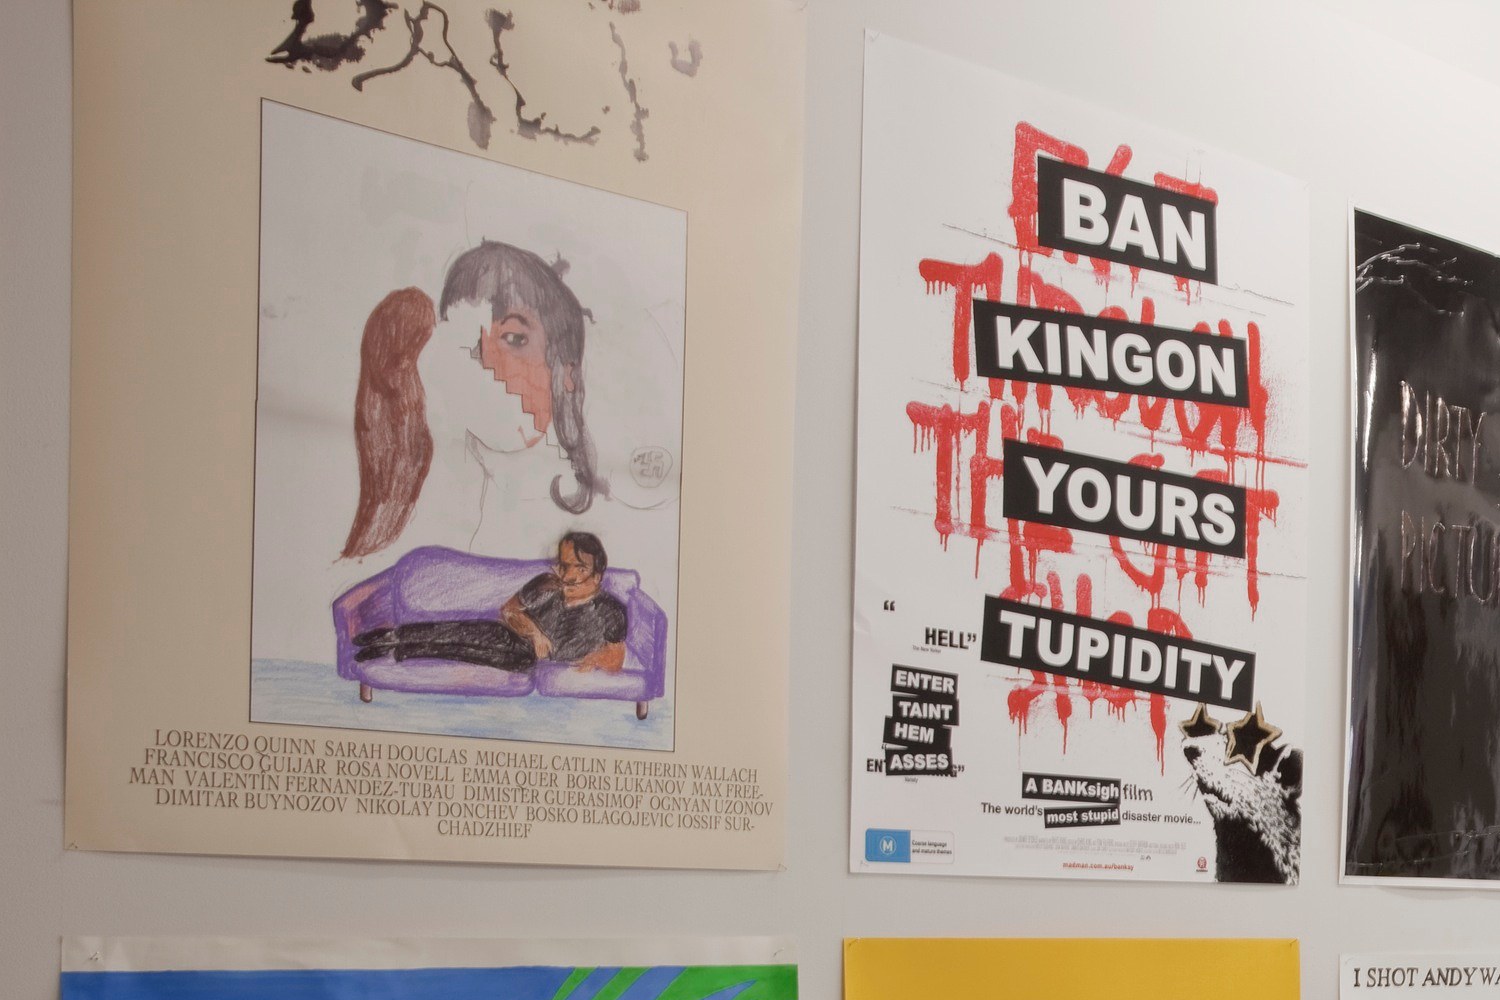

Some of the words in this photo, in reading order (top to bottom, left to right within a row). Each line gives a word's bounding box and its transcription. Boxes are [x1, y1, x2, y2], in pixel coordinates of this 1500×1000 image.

[1063, 177, 1206, 272] BAN
[996, 315, 1236, 398] KINGON
[1401, 380, 1487, 486] DIRTY
[1023, 456, 1236, 548] YOURS
[1000, 609, 1245, 700] TUPIDITY
[895, 669, 955, 694] ENTER
[899, 701, 952, 720] TAINT
[895, 722, 934, 744] HEM
[155, 729, 249, 751] LORENZO
[254, 735, 316, 757] QUINN
[325, 740, 382, 759] SARAH
[388, 743, 467, 765] DOUGLAS
[476, 750, 547, 770] MICHAEL
[551, 754, 606, 773] CATLIN
[614, 759, 687, 778] KATHERIN
[692, 764, 757, 783] WALLACH
[890, 753, 949, 771] ASSES
[145, 748, 254, 771] FRANCISCO
[337, 760, 381, 778] ROSA
[388, 762, 453, 782] NOVELL
[463, 767, 510, 785] EMMA
[515, 770, 558, 791] QUER
[567, 773, 610, 790] BORIS
[615, 776, 684, 795] LUKANOV
[692, 781, 722, 798] MAX
[726, 783, 763, 800] FREE-
[1026, 778, 1037, 793] A
[1043, 779, 1119, 801] BANKsigh
[1123, 784, 1152, 801] film
[129, 768, 174, 786] MAN
[286, 776, 454, 799] FERNANDEZ-TUBAU
[465, 785, 540, 804] DIMISTER
[650, 795, 710, 813] OGNYAN
[714, 800, 773, 816] UZONOV
[156, 787, 239, 808] DIMITAR
[245, 792, 347, 813] BUYNOZOV
[356, 798, 431, 817] NIKOLAY
[438, 802, 517, 821] DONCHEV
[526, 806, 578, 823] BOSKO
[583, 809, 674, 828] BLAGOJEVIC
[677, 814, 721, 829] IOSSIF
[725, 817, 754, 831] SUR-
[438, 819, 531, 838] CHADZHIEF
[981, 802, 1001, 814] The
[1047, 812, 1078, 825] most
[1082, 808, 1119, 824] stupid
[1122, 811, 1161, 822] disaster
[883, 839, 893, 851] M
[1354, 968, 1360, 987] I
[1367, 968, 1418, 987] SHOT
[1422, 968, 1477, 986] ANDY
